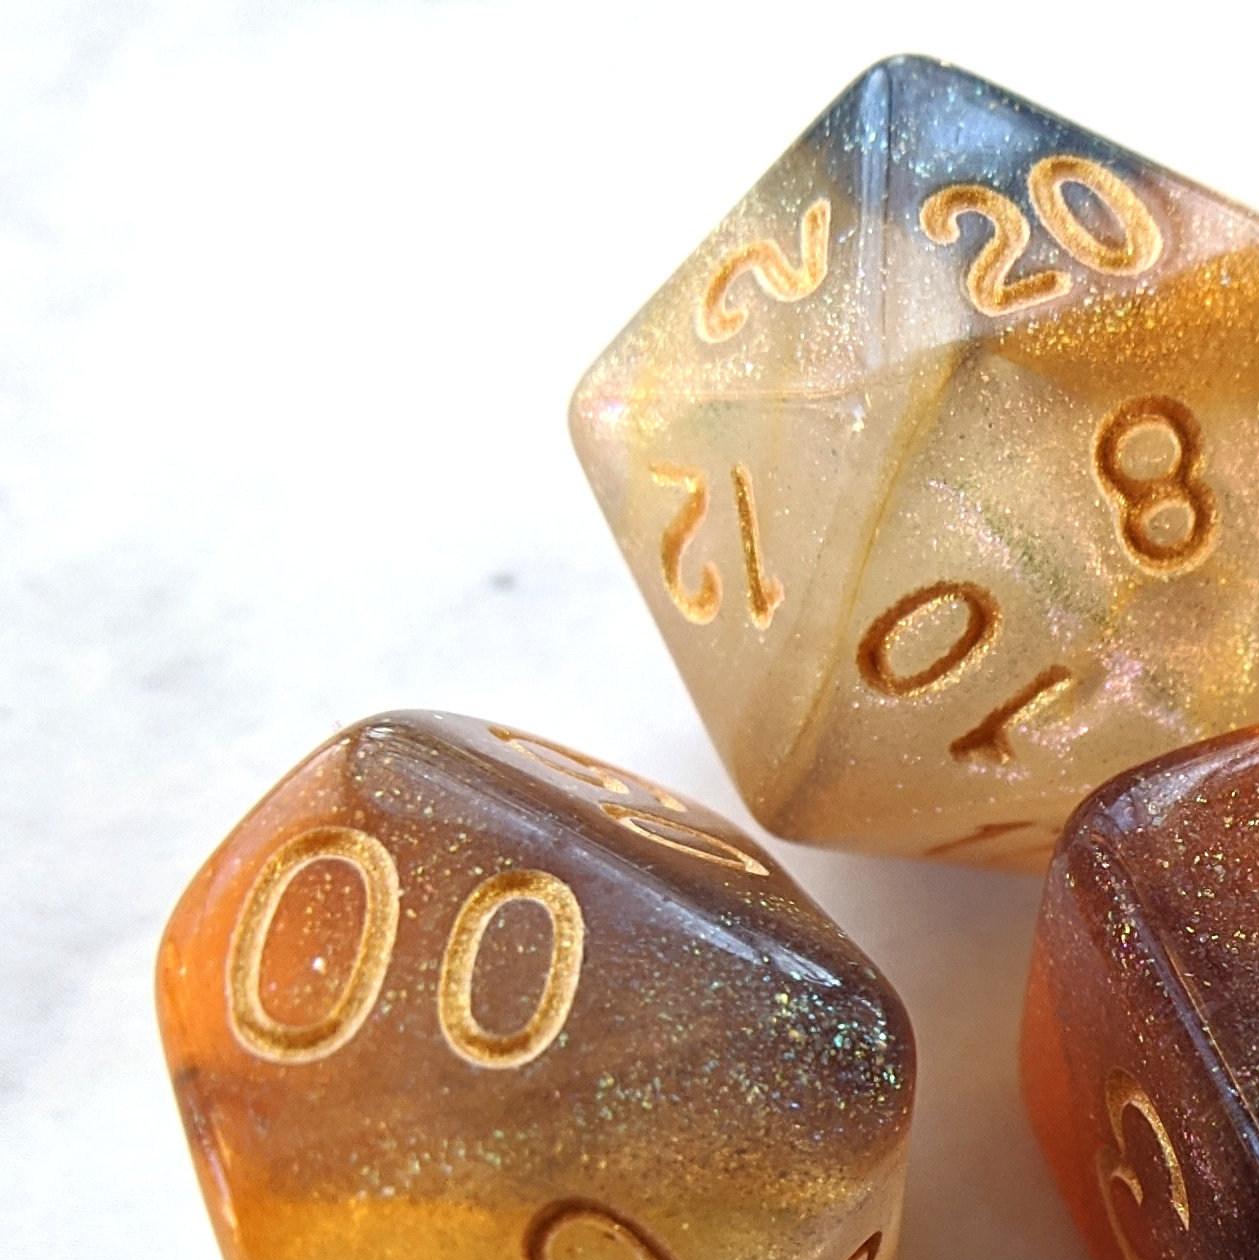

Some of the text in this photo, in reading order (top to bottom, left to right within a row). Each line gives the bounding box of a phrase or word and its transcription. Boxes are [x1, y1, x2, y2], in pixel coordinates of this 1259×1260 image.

[696, 198, 833, 344] 2
[920, 156, 1163, 318] 20
[648, 461, 785, 632] 12
[1094, 397, 1218, 577] 8
[856, 580, 1076, 766] 10
[225, 826, 587, 1070] 00
